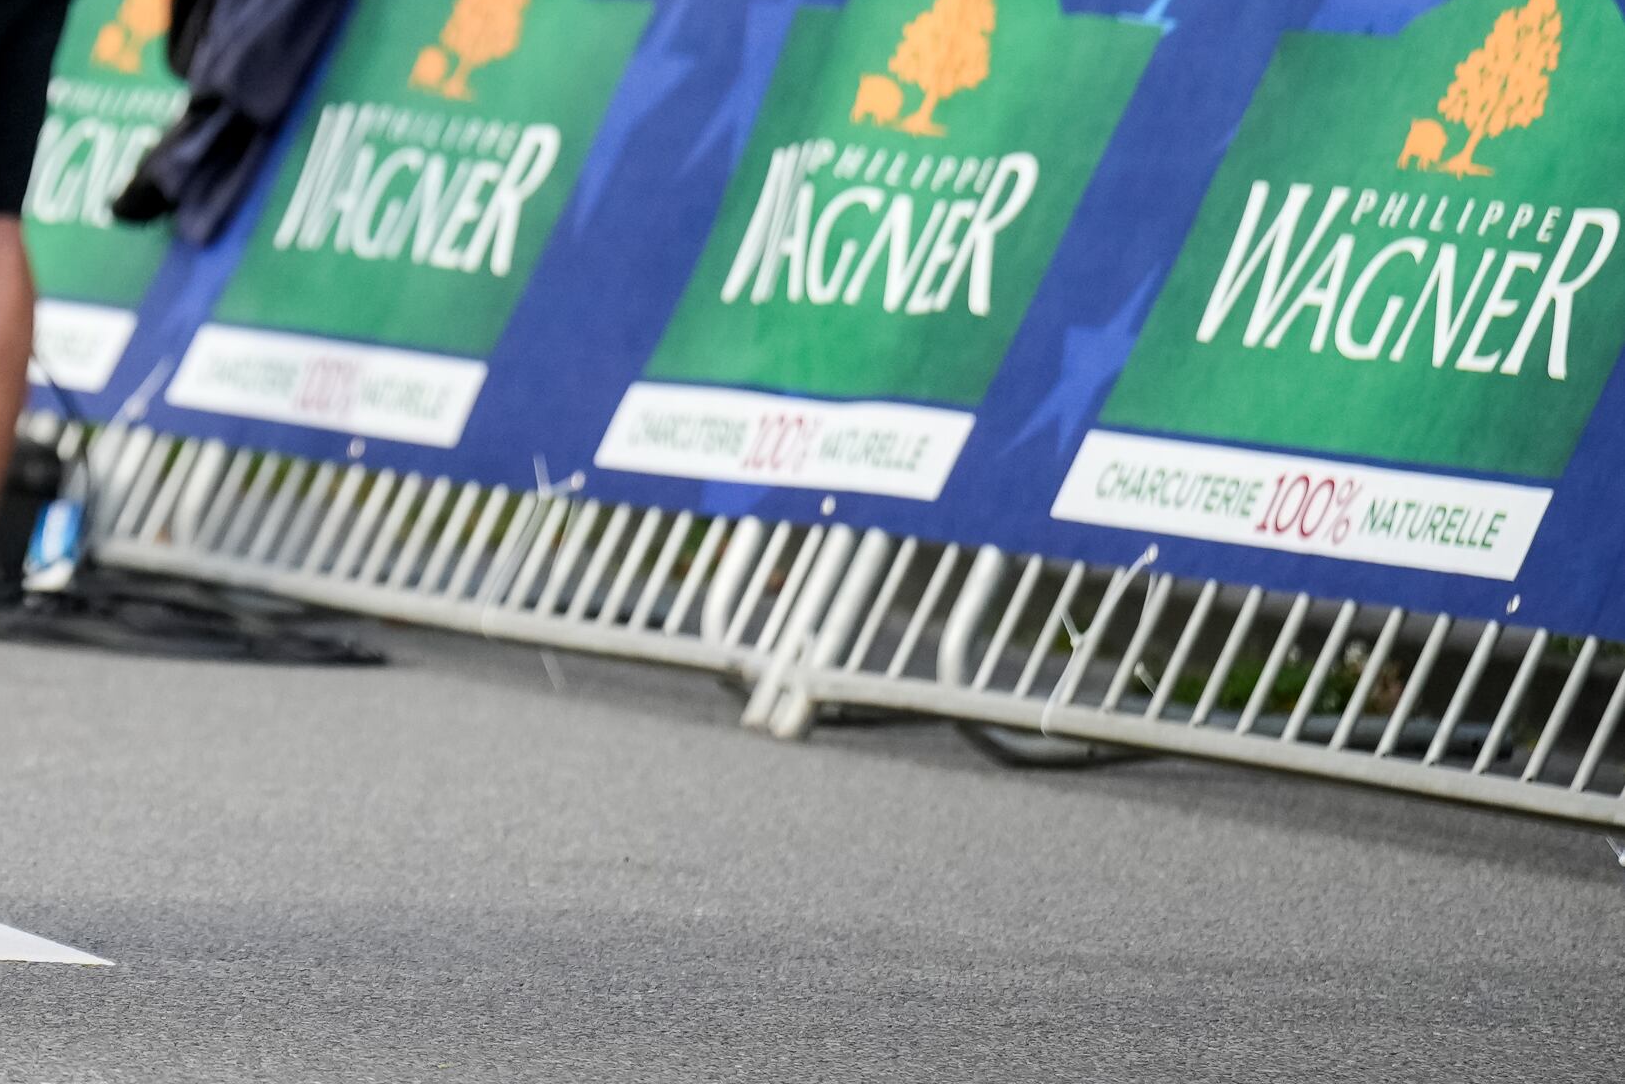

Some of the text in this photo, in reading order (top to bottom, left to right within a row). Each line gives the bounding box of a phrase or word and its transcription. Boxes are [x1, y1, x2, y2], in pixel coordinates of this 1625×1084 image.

[275, 102, 561, 276] WAGNER
[720, 143, 1039, 316] WAGNER
[1350, 187, 1563, 243] PHILIPPE
[1196, 180, 1620, 380] WAGNER
[1093, 460, 1507, 552] CHARCUTERIE 100% NATURELLE
